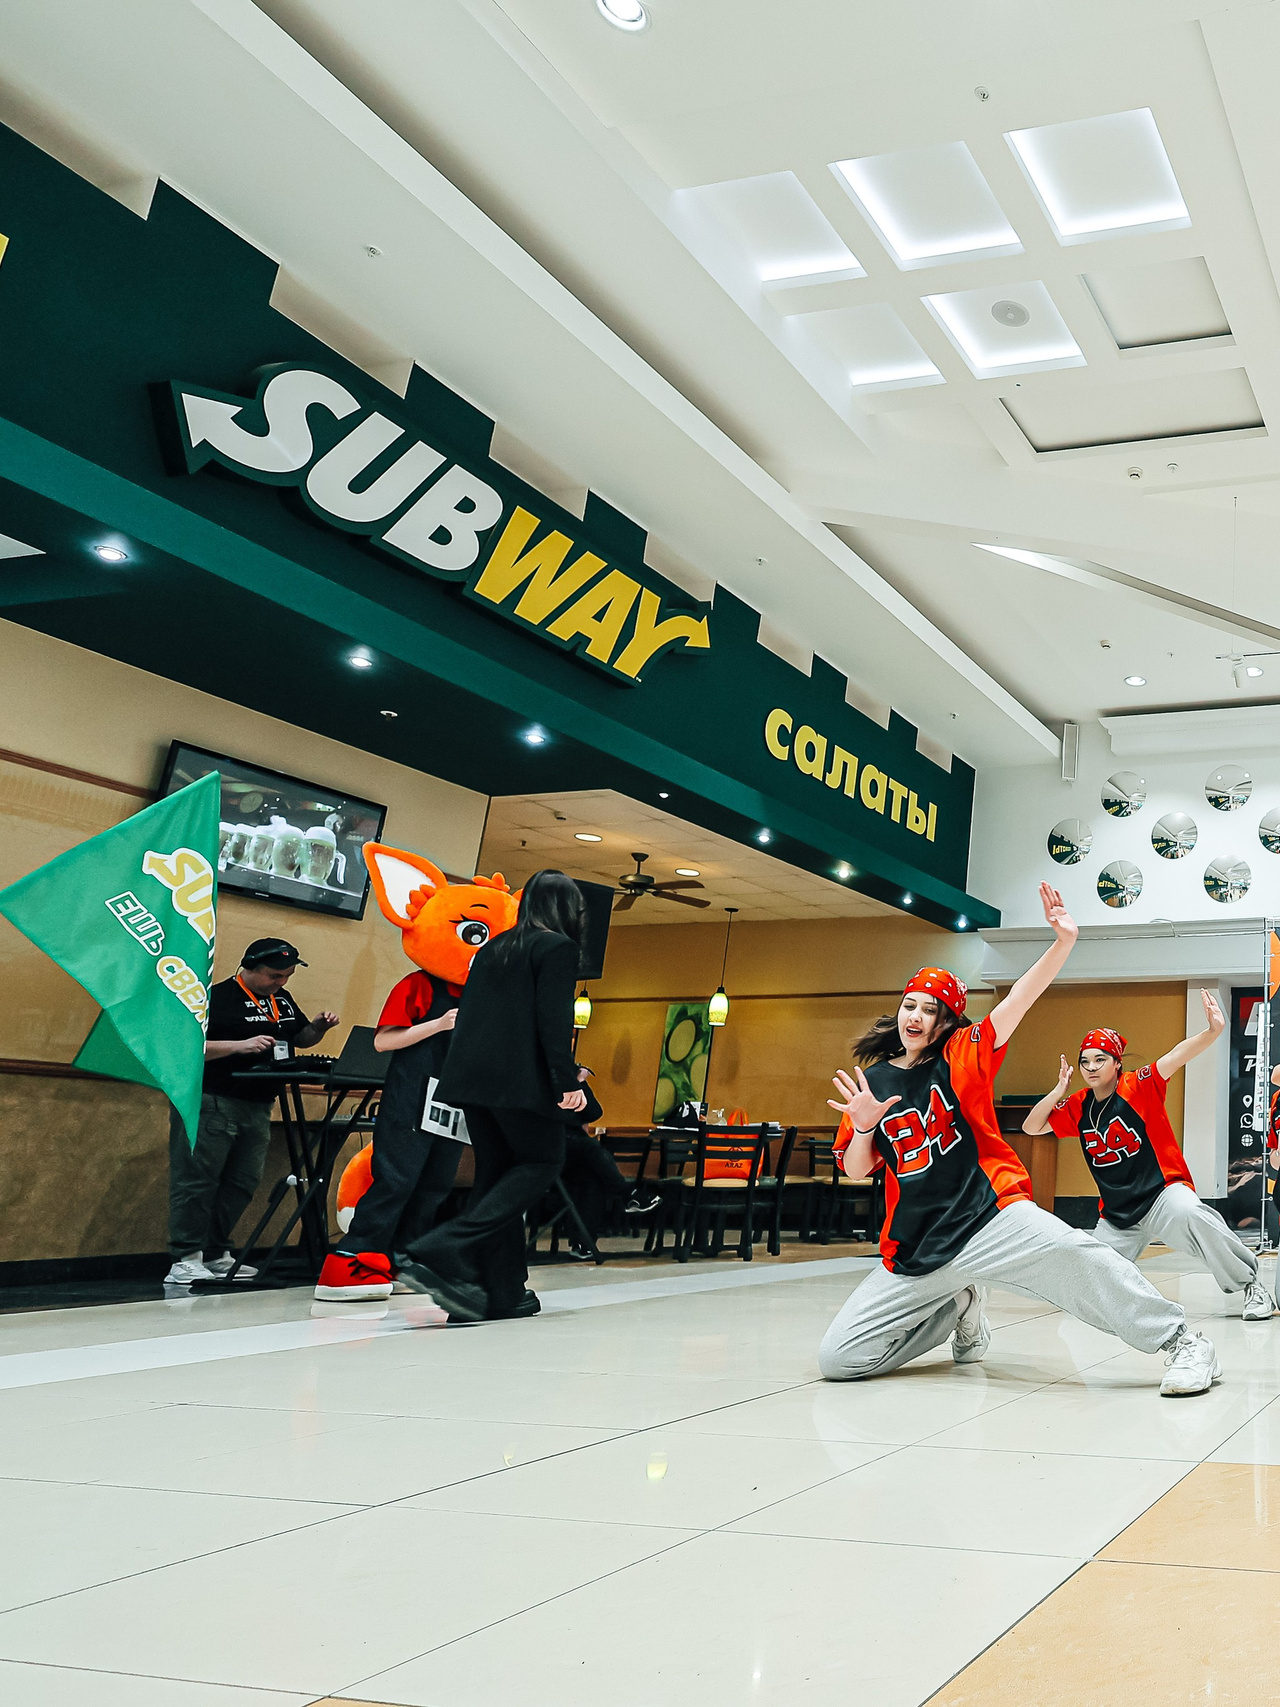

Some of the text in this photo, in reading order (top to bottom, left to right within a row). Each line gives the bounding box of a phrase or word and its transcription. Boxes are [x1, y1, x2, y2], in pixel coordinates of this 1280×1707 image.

[181, 369, 711, 679] SUBWAY
[764, 708, 938, 843] салаты
[105, 891, 165, 956] ЕШЬ
[881, 1084, 962, 1177] 24
[1083, 1116, 1142, 1167] 24
